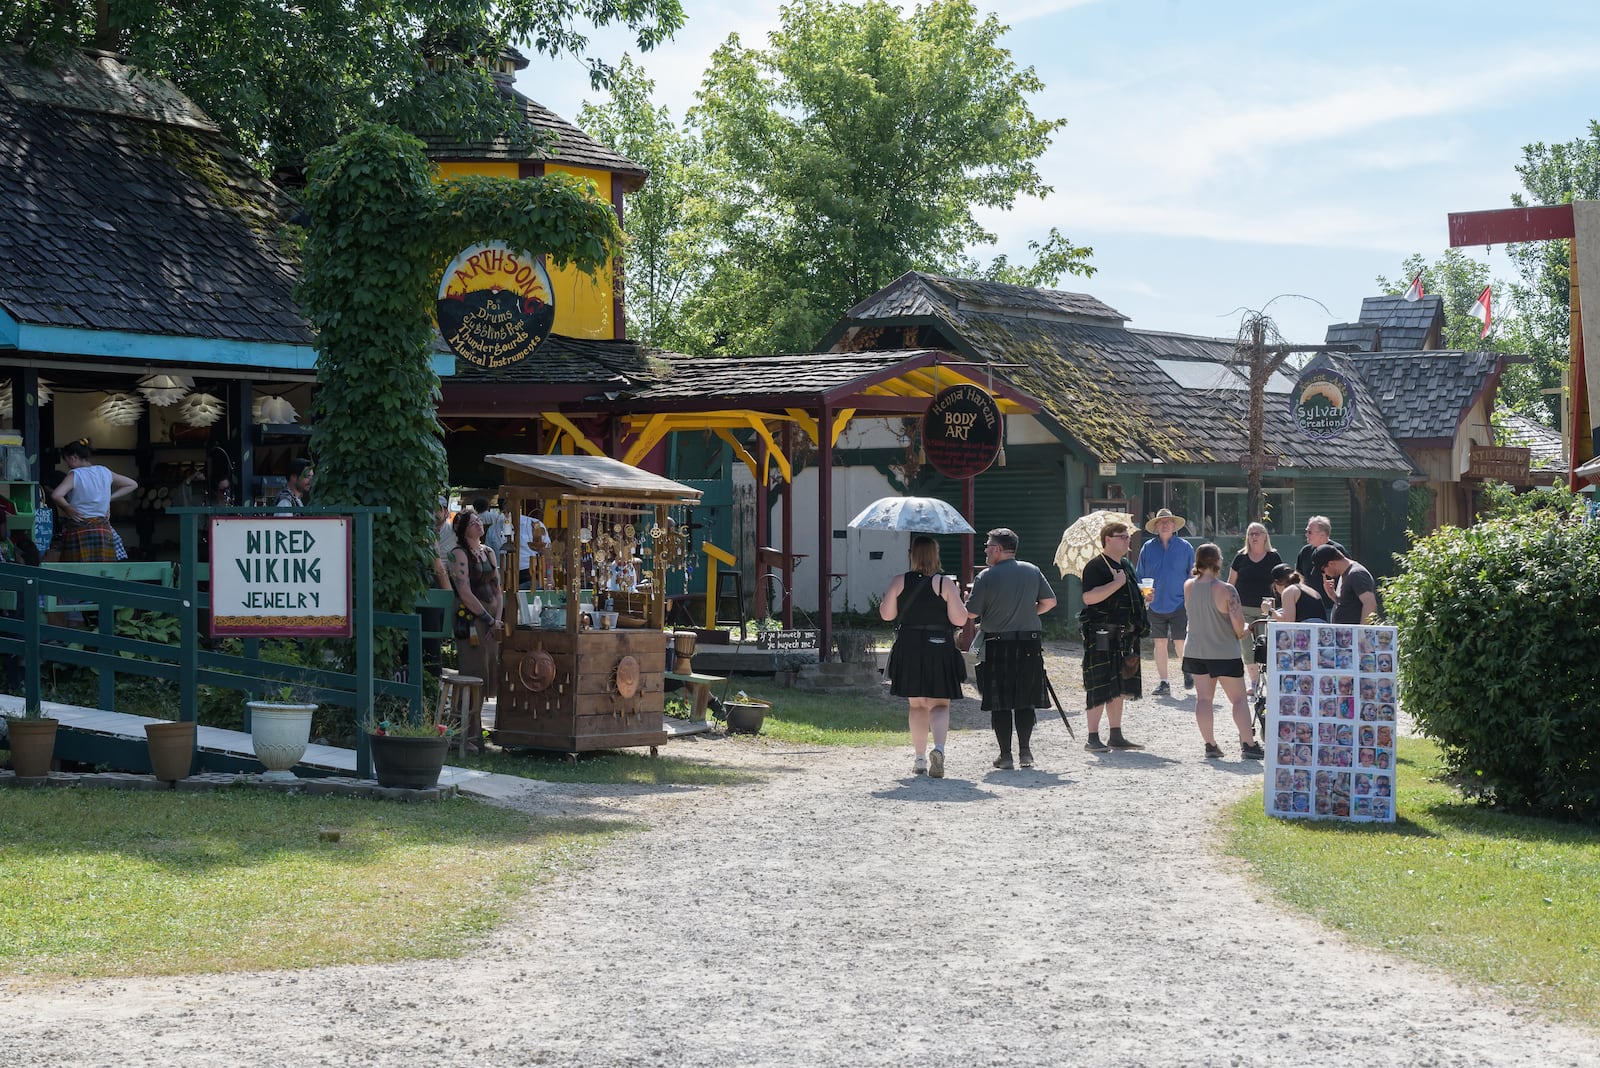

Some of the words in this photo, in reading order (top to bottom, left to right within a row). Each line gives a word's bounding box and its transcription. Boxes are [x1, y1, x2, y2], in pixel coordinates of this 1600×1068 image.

[446, 249, 544, 315] EARTHSONG
[487, 299, 500, 310] Poi
[476, 308, 513, 324] Drums
[463, 313, 508, 341] Juggling
[506, 318, 525, 336] Props
[458, 323, 529, 356] Thundergourds
[448, 334, 486, 367] Musical
[488, 335, 542, 369] Instruments
[932, 389, 963, 415] Henna
[966, 388, 996, 430] Harem
[1297, 405, 1348, 420] Sylvan
[945, 411, 977, 427] BODY
[1299, 417, 1346, 430] Creations
[945, 425, 971, 441] ART
[1472, 450, 1527, 464] STICKBOW
[1471, 464, 1527, 478] ARCHERY
[246, 529, 316, 555] WIRED
[234, 557, 321, 584] VIKING
[241, 591, 320, 609] JEWELRY
